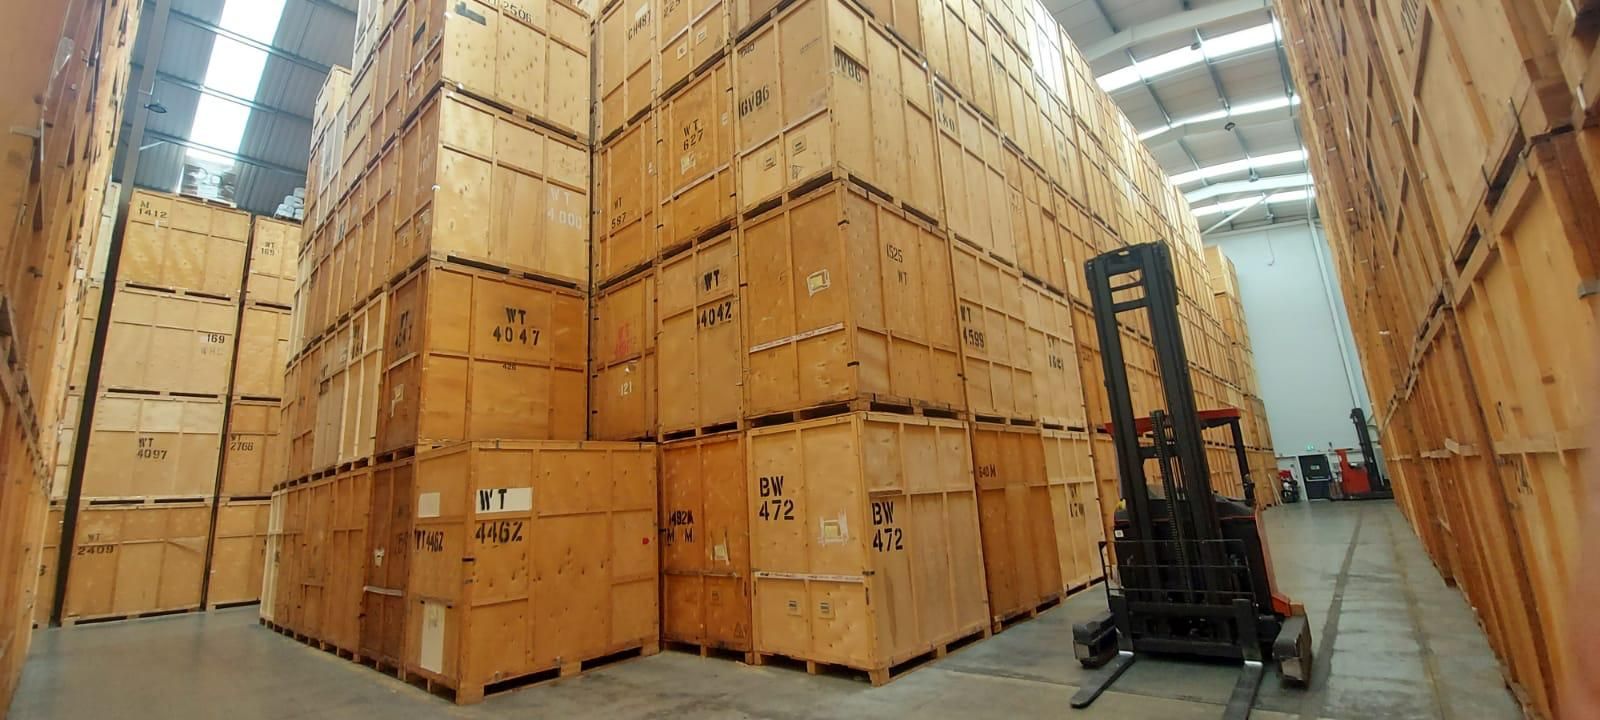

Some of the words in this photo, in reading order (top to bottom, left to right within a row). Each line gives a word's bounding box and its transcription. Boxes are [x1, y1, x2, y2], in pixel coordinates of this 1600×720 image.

[683, 127, 703, 150] 627
[139, 208, 168, 218] 1412
[704, 269, 720, 291] WT
[505, 307, 526, 325] WT
[207, 333, 225, 344] 169
[492, 325, 540, 346] 4047
[138, 437, 154, 448] WT
[136, 448, 168, 460] 4097
[759, 475, 784, 498] BW
[758, 499, 795, 521] 472
[871, 501, 894, 526] BW
[474, 520, 523, 545] 4462
[872, 527, 904, 553] 472
[77, 544, 114, 556] 2409
